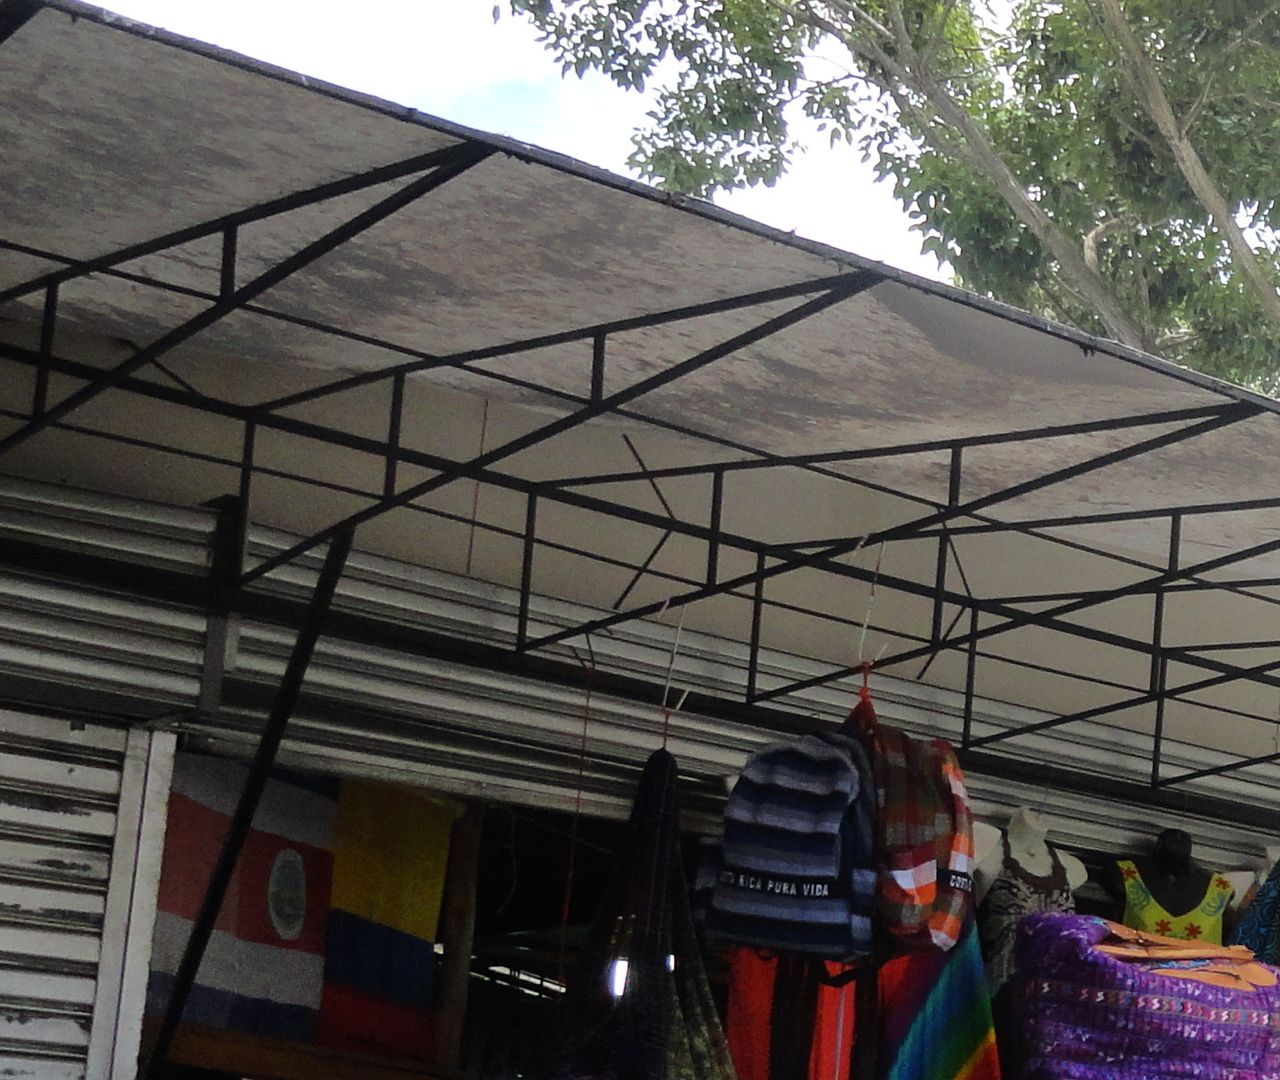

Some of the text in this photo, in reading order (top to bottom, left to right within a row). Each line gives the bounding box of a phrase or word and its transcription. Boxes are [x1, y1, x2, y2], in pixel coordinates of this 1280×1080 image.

[738, 874, 761, 890] RICA
[767, 880, 797, 895] PURA
[803, 883, 829, 896] VIDA
